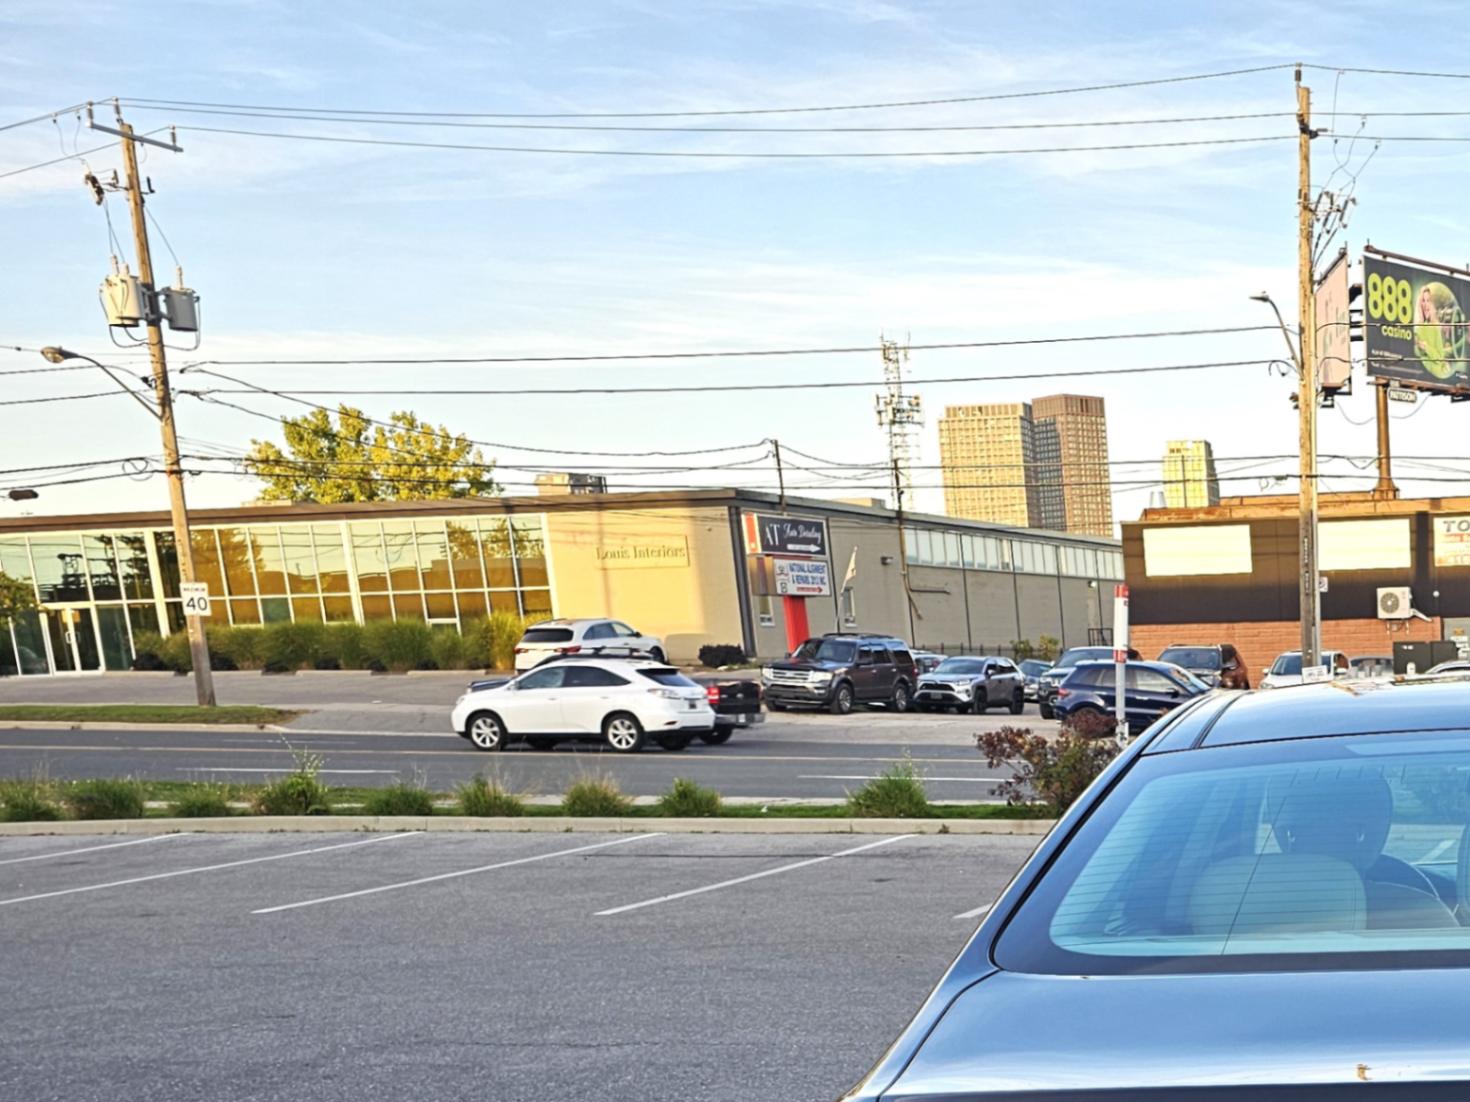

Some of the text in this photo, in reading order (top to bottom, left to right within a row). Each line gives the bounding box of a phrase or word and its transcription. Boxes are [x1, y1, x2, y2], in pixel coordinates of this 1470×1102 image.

[1368, 273, 1412, 324] 888
[1381, 325, 1412, 340] casino
[764, 523, 780, 546] AT
[596, 545, 686, 560] Louis Interiors
[186, 597, 207, 611] 40
